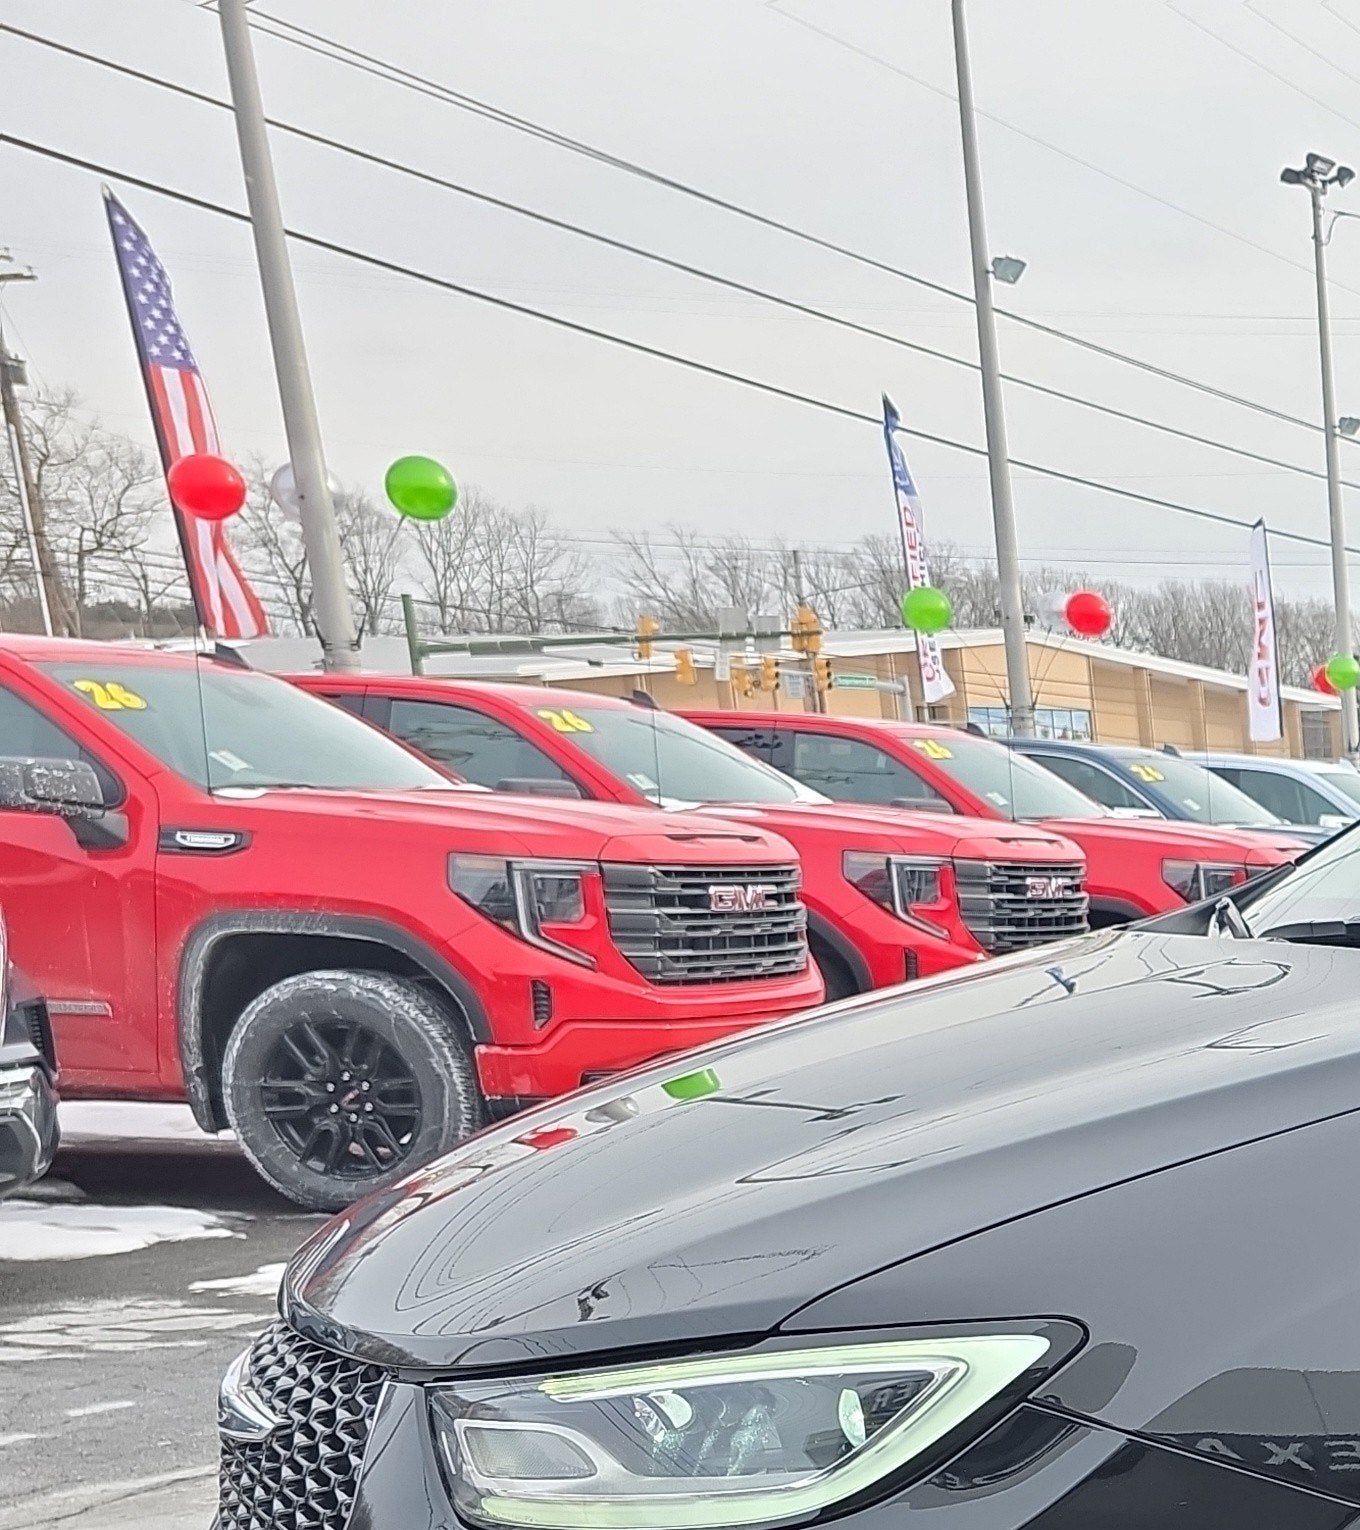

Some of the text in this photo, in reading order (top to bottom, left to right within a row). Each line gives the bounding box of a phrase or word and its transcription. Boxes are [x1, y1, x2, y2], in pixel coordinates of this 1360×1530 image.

[73, 679, 148, 711] 26
[537, 709, 595, 733] 26
[708, 884, 778, 912] GMC
[1025, 876, 1073, 899] GMC
